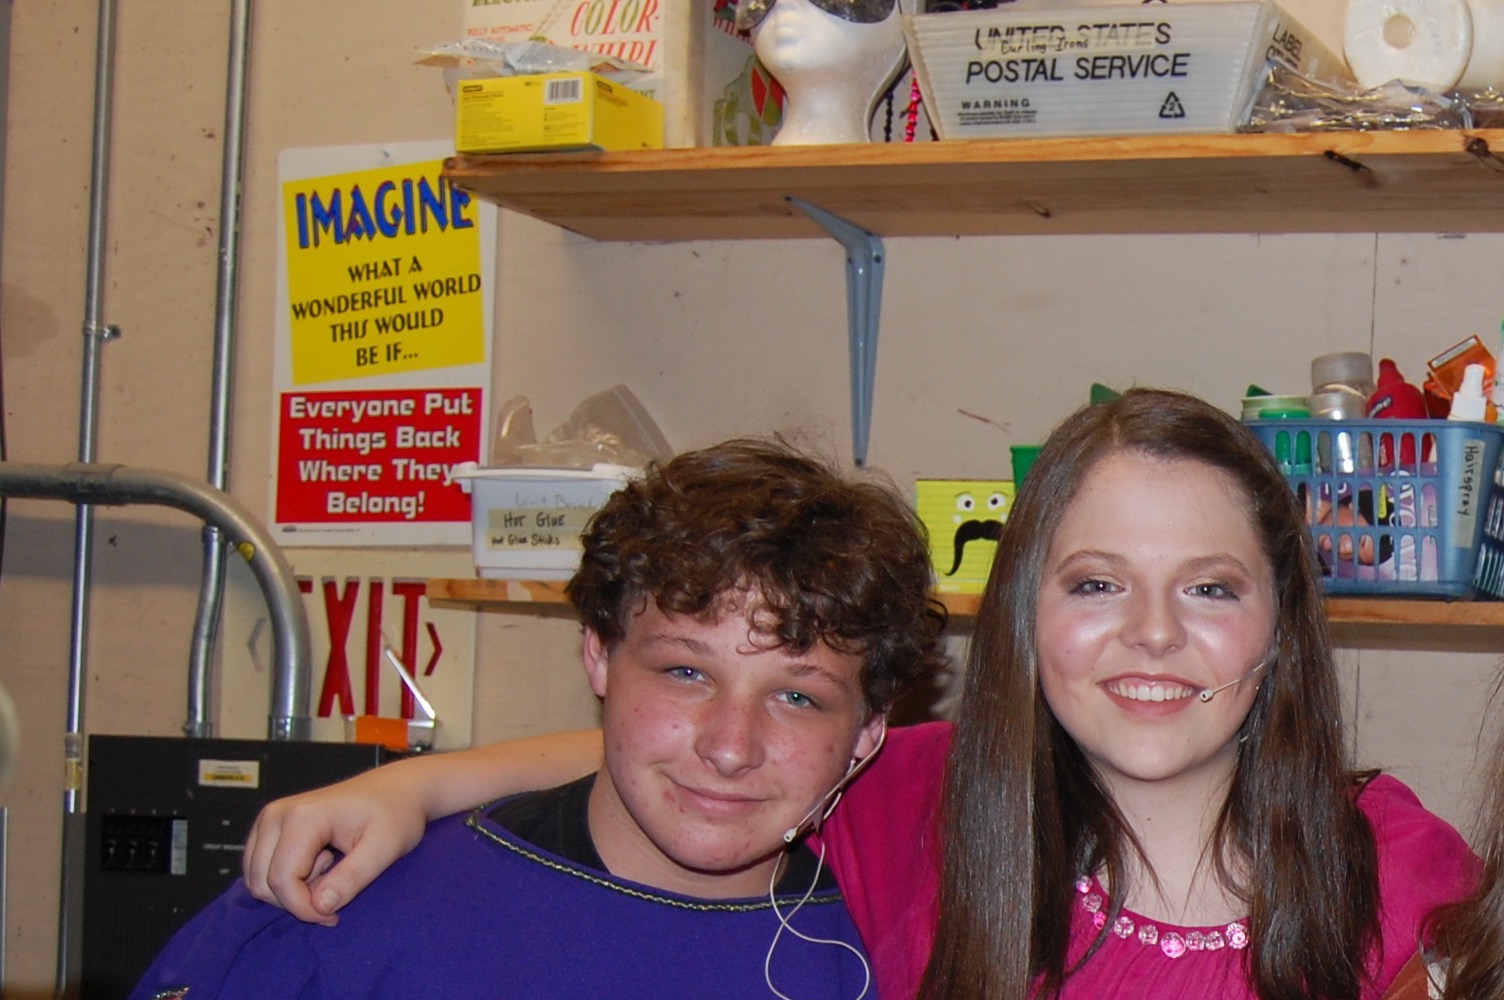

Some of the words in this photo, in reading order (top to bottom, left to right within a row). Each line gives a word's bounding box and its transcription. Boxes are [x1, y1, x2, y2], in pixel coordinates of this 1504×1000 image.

[1000, 38, 1047, 55] Curling
[1055, 36, 1089, 52] Irons
[1076, 22, 1173, 47] STATES
[1272, 23, 1304, 62] LABEL
[965, 58, 1065, 85] POSTAL
[1074, 53, 1191, 80] SERVICE
[961, 98, 1031, 110] WARNING
[295, 174, 474, 249] IMAGINE
[348, 257, 402, 283] WHAT
[408, 255, 423, 274] A
[291, 285, 407, 320] WONDERFUL
[413, 273, 481, 301] WORLD
[329, 319, 369, 343] THIS
[375, 308, 444, 335] WOULD
[356, 345, 379, 367] BE
[386, 341, 419, 362] IF...
[289, 396, 416, 424] Everyone
[424, 392, 474, 416] Put
[299, 427, 387, 455] Things
[396, 425, 461, 449] Back
[298, 460, 383, 483] Where
[391, 458, 460, 487] They
[1458, 445, 1479, 517] Hairspray
[326, 491, 426, 520] Belong!
[296, 579, 428, 719] XIT
